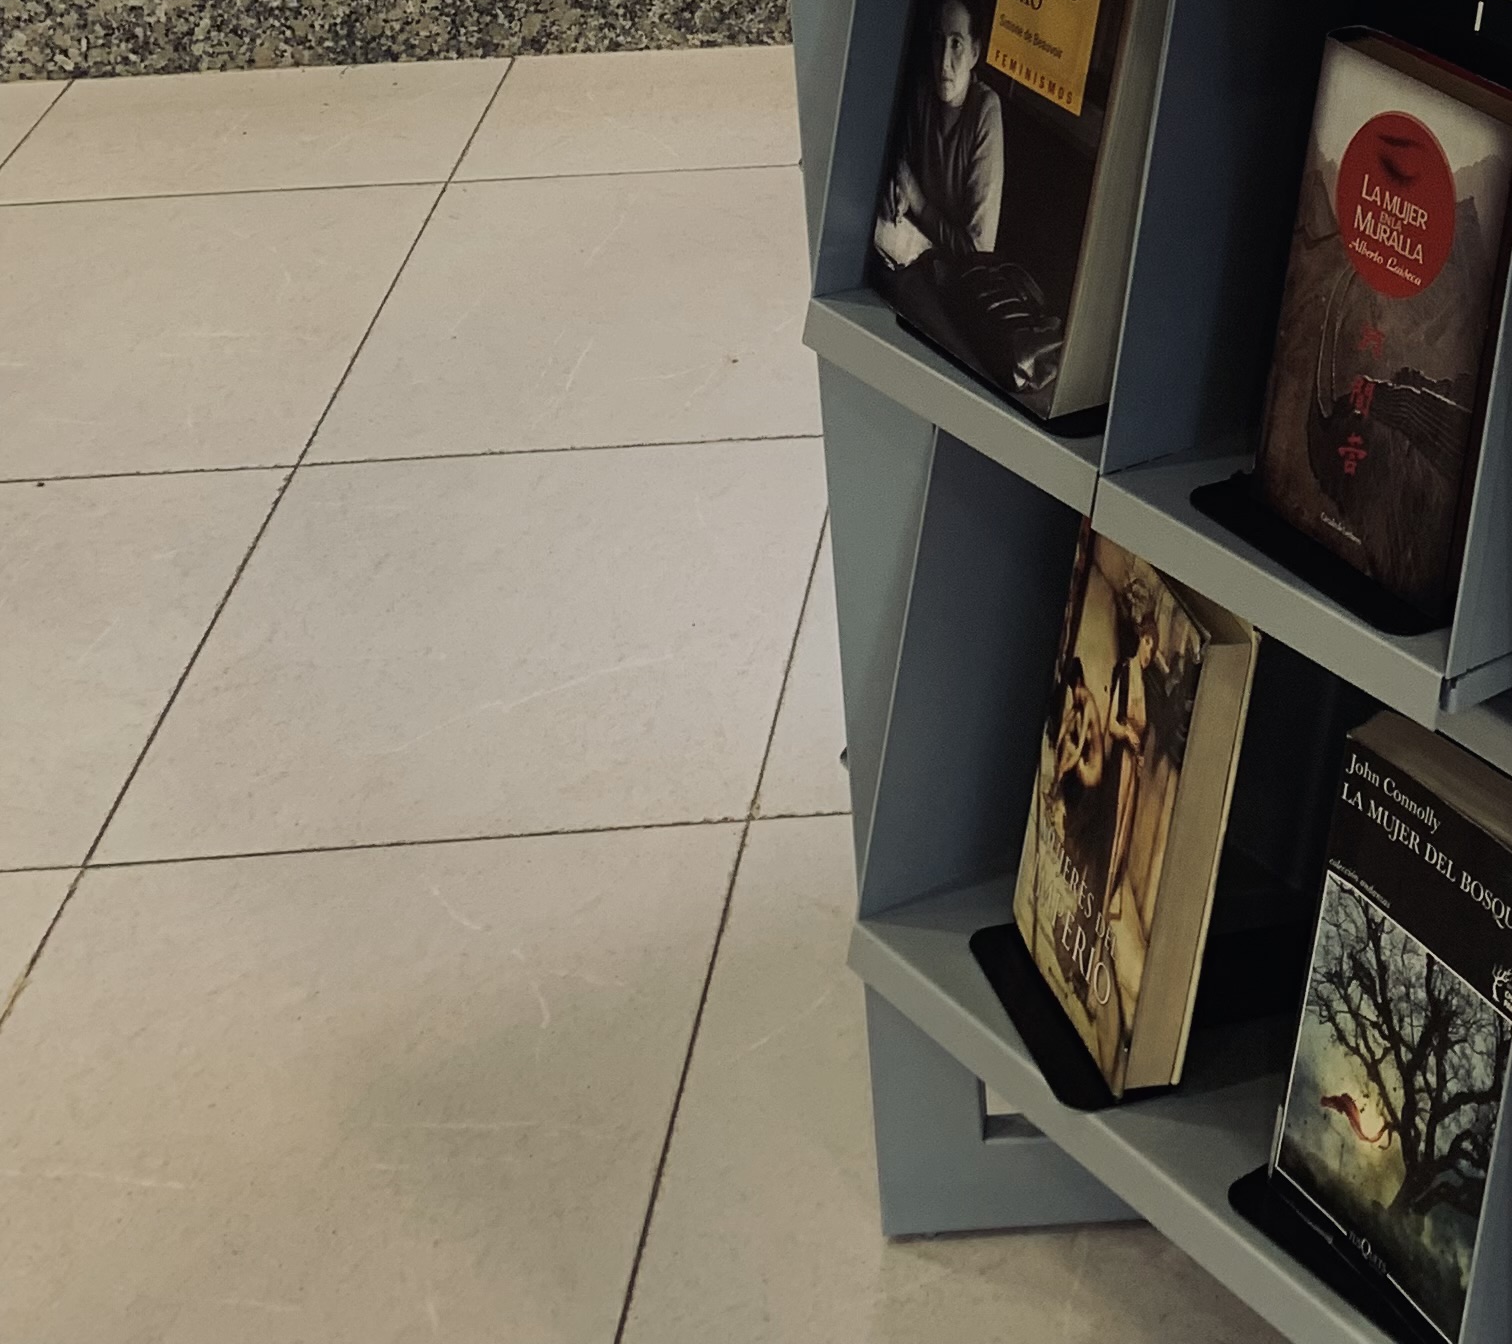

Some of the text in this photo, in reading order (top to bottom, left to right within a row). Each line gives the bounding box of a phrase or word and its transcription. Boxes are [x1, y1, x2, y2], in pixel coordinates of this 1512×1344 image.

[995, 49, 1073, 105] FEMINISMOS
[1362, 173, 1428, 231] LA MUJER
[1380, 210, 1403, 232] EN LA
[1348, 237, 1384, 265] Alberto
[1353, 204, 1424, 265] MURALLA
[1345, 753, 1441, 834] John Connolly
[1341, 782, 1364, 811] LA
[1367, 799, 1420, 855] MUJER
[1424, 842, 1457, 883] DEL
[1095, 911, 1118, 960] DEL
